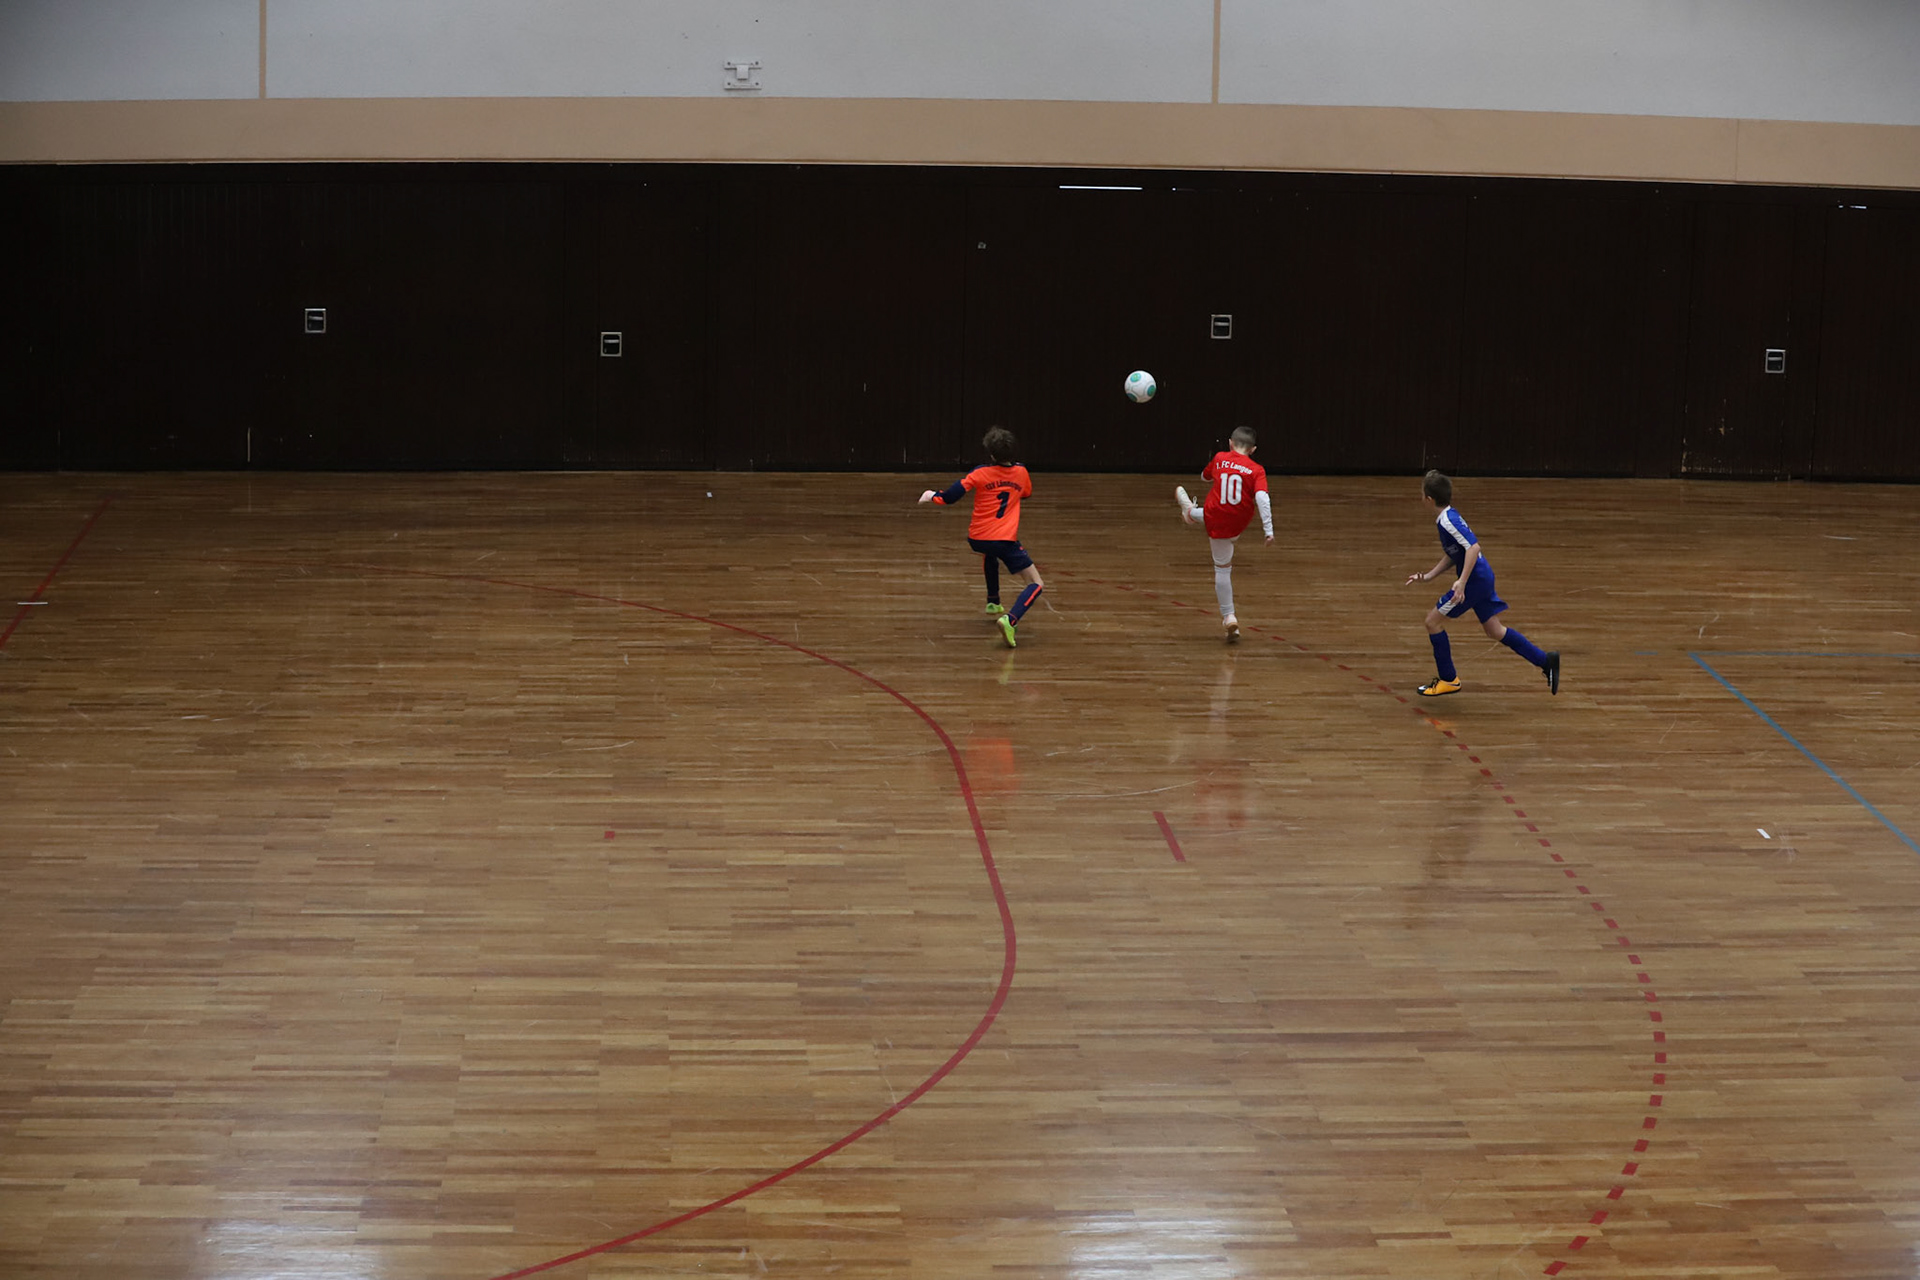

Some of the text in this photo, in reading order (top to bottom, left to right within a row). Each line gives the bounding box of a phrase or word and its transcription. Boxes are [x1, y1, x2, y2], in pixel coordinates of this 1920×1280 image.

[1221, 460, 1230, 468] FC
[1230, 462, 1253, 475] Langen
[1220, 472, 1243, 505] 10
